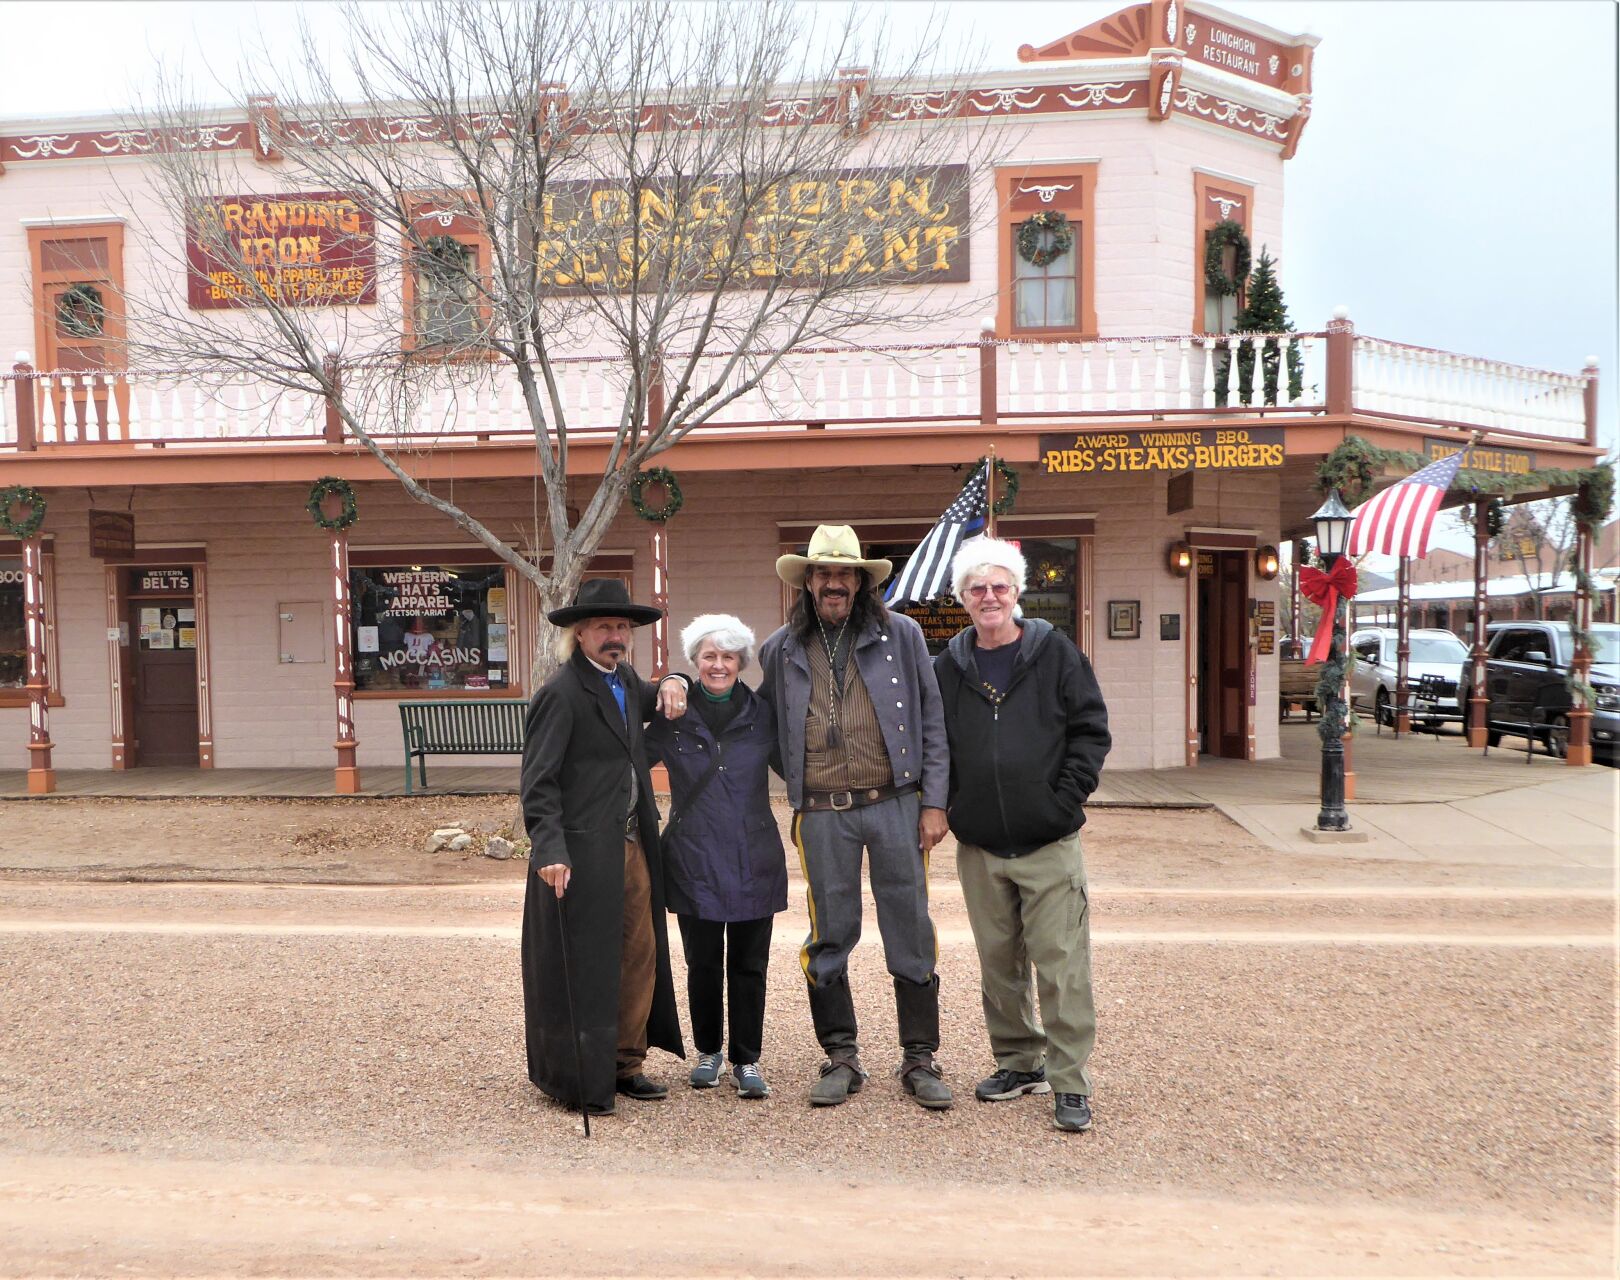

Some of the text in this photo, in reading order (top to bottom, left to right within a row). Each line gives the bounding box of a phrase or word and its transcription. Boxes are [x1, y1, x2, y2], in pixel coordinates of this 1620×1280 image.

[1211, 27, 1256, 55] LONGHORN
[1204, 45, 1260, 76] RESTAURANT
[240, 235, 322, 265] IRON
[1074, 430, 1252, 449] AWARD WINNING BBQ
[1504, 453, 1530, 474] FOOD
[143, 577, 190, 589] BELTS
[383, 571, 450, 584] WESTERN
[402, 583, 440, 596] HATS
[391, 595, 455, 609] APPAREL
[385, 609, 420, 617] STETSON
[937, 607, 967, 615] WINNIN
[379, 647, 481, 671] MOCCASINS
